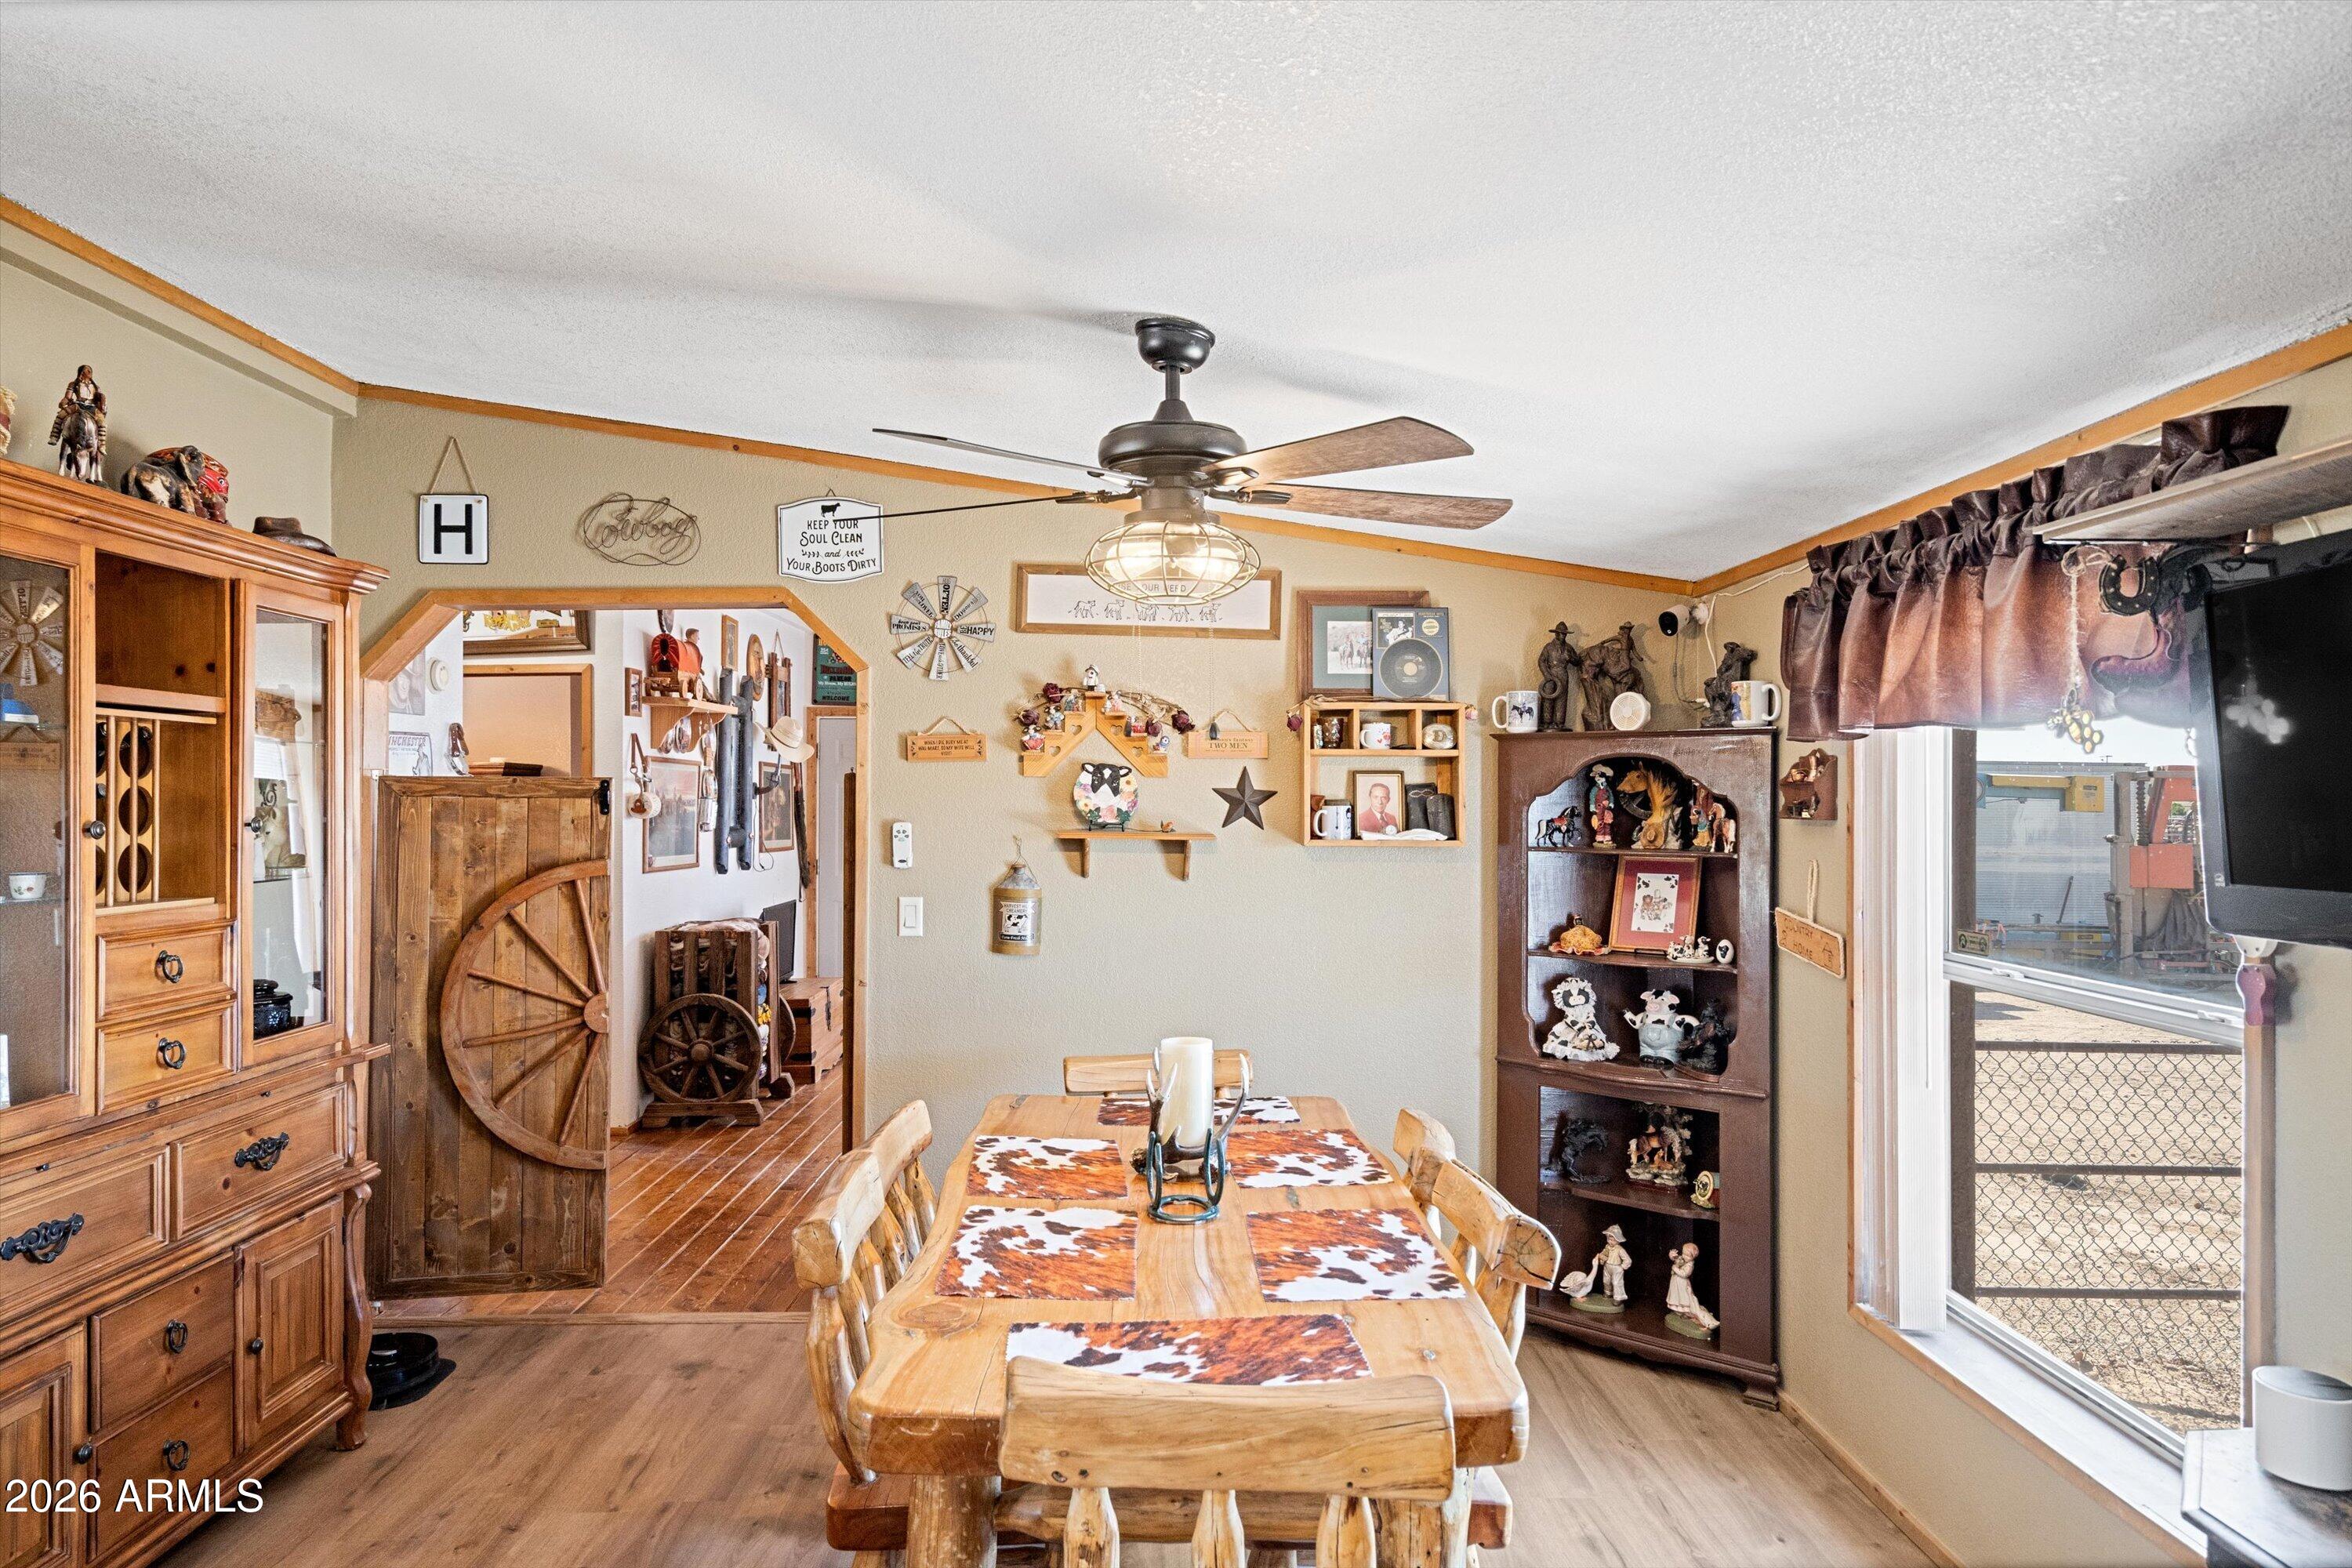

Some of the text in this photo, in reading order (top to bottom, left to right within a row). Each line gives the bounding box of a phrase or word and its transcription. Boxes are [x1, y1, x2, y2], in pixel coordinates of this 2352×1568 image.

[434, 503, 473, 554] H
[807, 519, 858, 530] KEEP YOUR
[800, 531, 862, 546] SOUL CLEAN
[824, 549, 841, 557] and
[786, 557, 877, 575] YOUR BOOTS DIRTY
[941, 584, 951, 614] OFTEN
[967, 626, 994, 636] HAPPY
[389, 735, 426, 746] INCHESTER
[1784, 917, 1813, 939] COUNTRY
[1793, 941, 1813, 960] HOME
